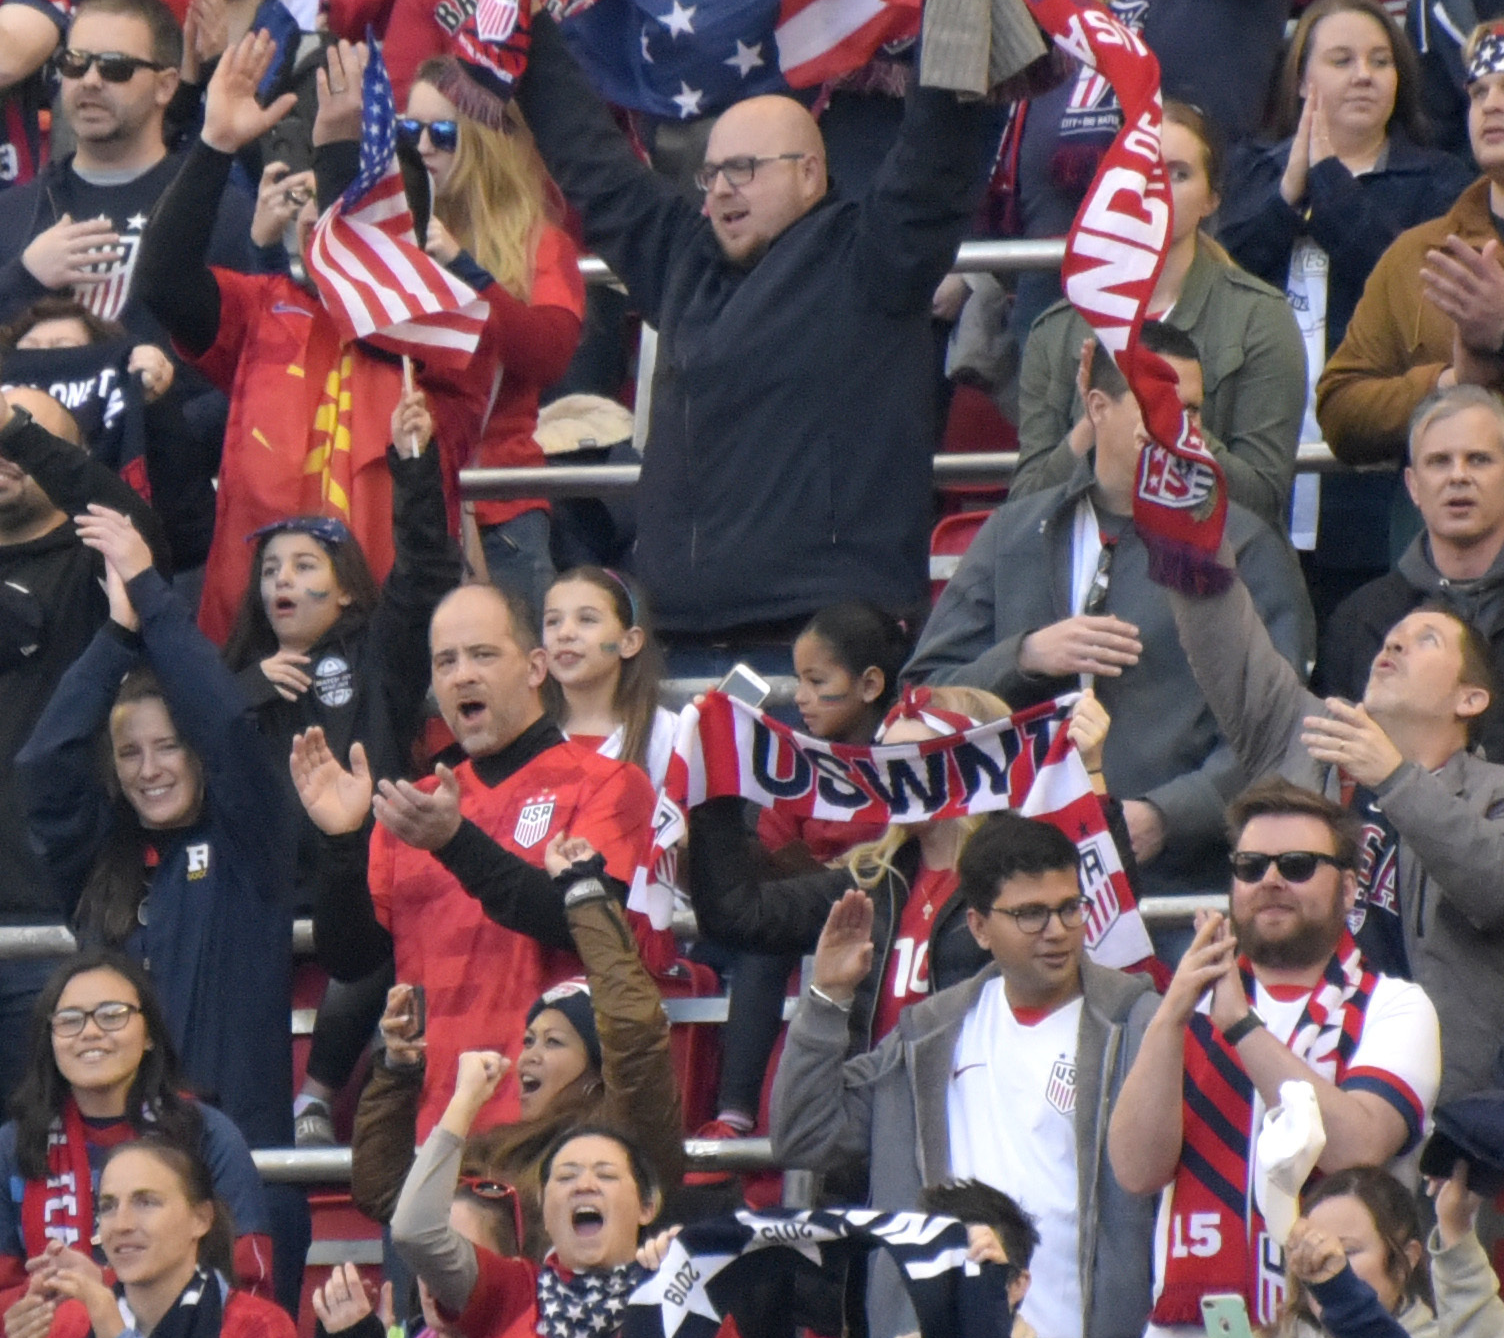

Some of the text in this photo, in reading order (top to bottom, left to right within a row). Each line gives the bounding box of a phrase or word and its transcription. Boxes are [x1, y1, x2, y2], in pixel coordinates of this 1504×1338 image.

[523, 806, 552, 825] USA
[1172, 1212, 1223, 1258] 15
[664, 1259, 702, 1308] 2019
